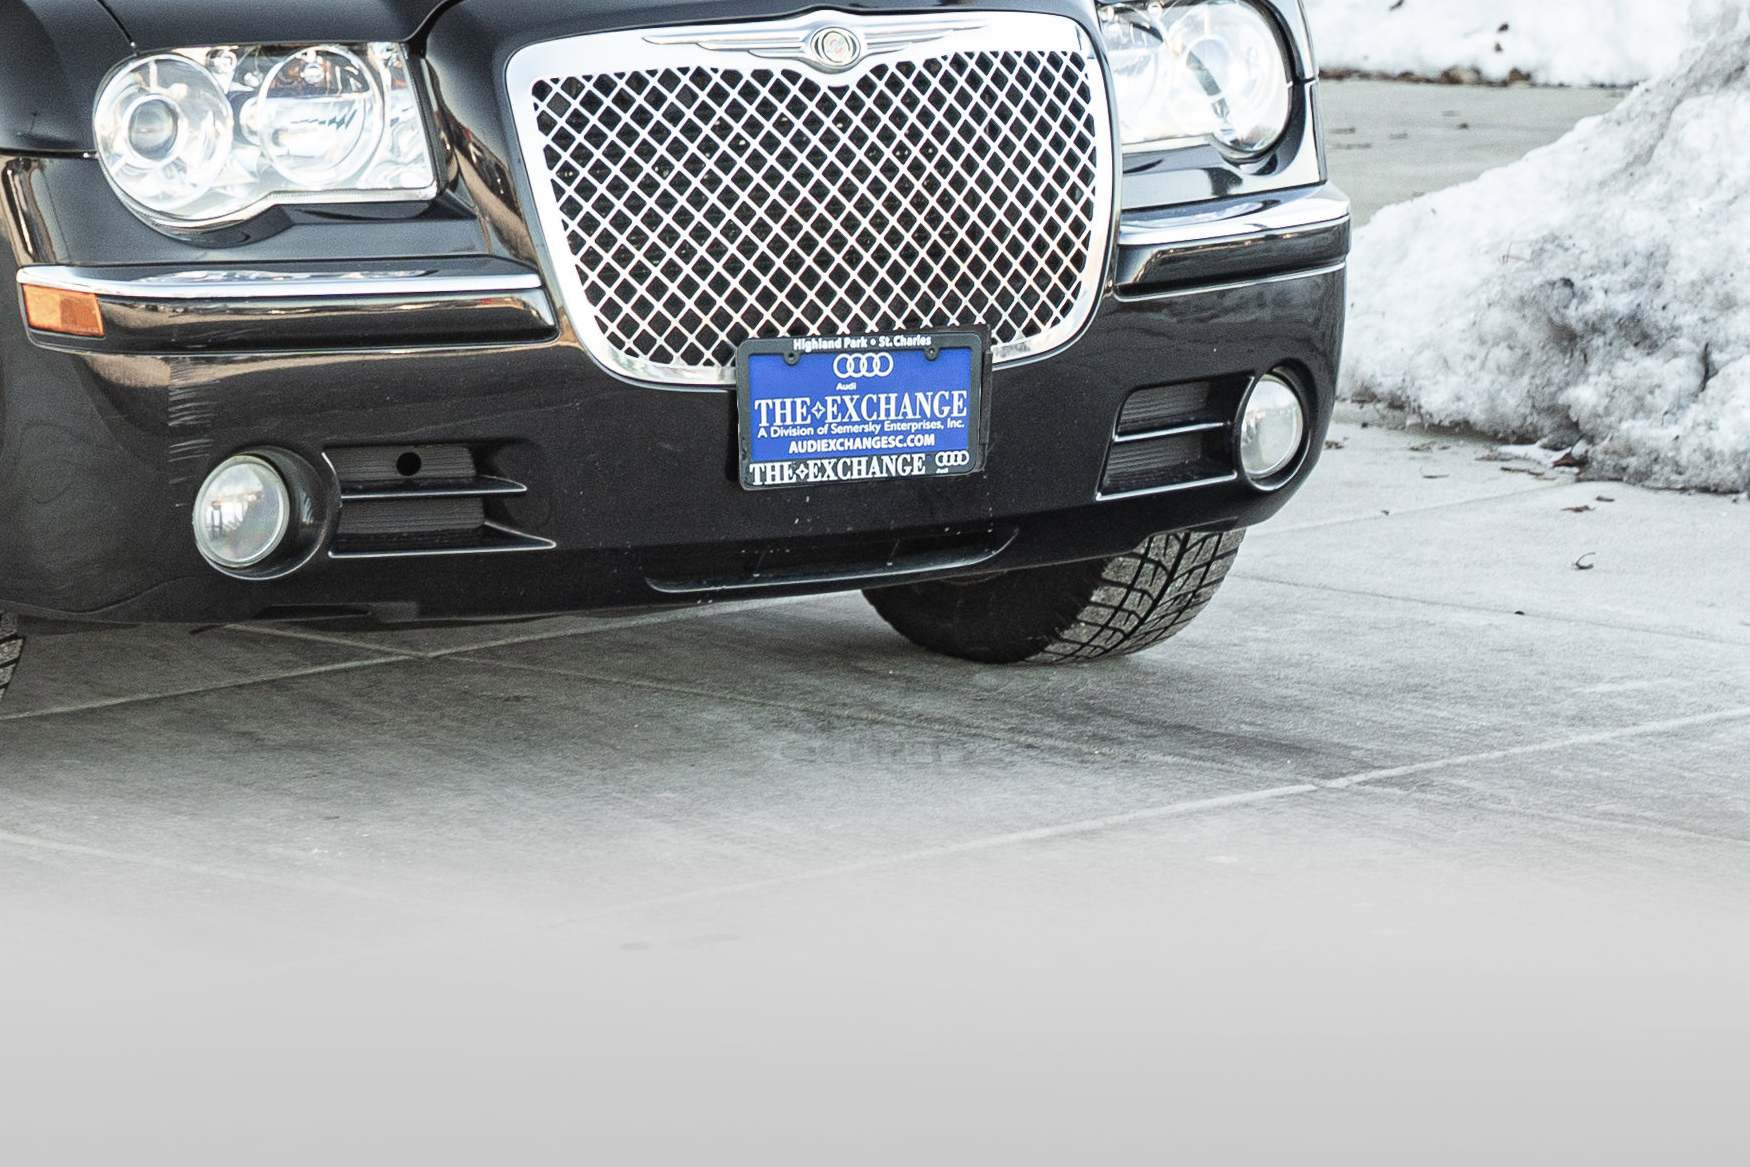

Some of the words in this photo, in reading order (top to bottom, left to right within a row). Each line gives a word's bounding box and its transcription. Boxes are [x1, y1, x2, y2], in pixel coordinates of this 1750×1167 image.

[793, 337, 842, 353] Highland
[843, 336, 868, 349] Park
[893, 334, 932, 347] Charles
[836, 382, 857, 391] Audi
[754, 397, 812, 427] THE
[824, 390, 968, 423] EXCHANGE
[757, 427, 768, 439] A
[770, 425, 814, 438] Division
[816, 423, 830, 435] of
[830, 421, 881, 435] Semersky
[883, 419, 944, 433] Enterprises,
[946, 417, 965, 429] Inc.
[788, 433, 935, 454] AUDIEXCHANGESC.COM
[749, 461, 797, 486] THE
[806, 452, 926, 483] EXCHANGE
